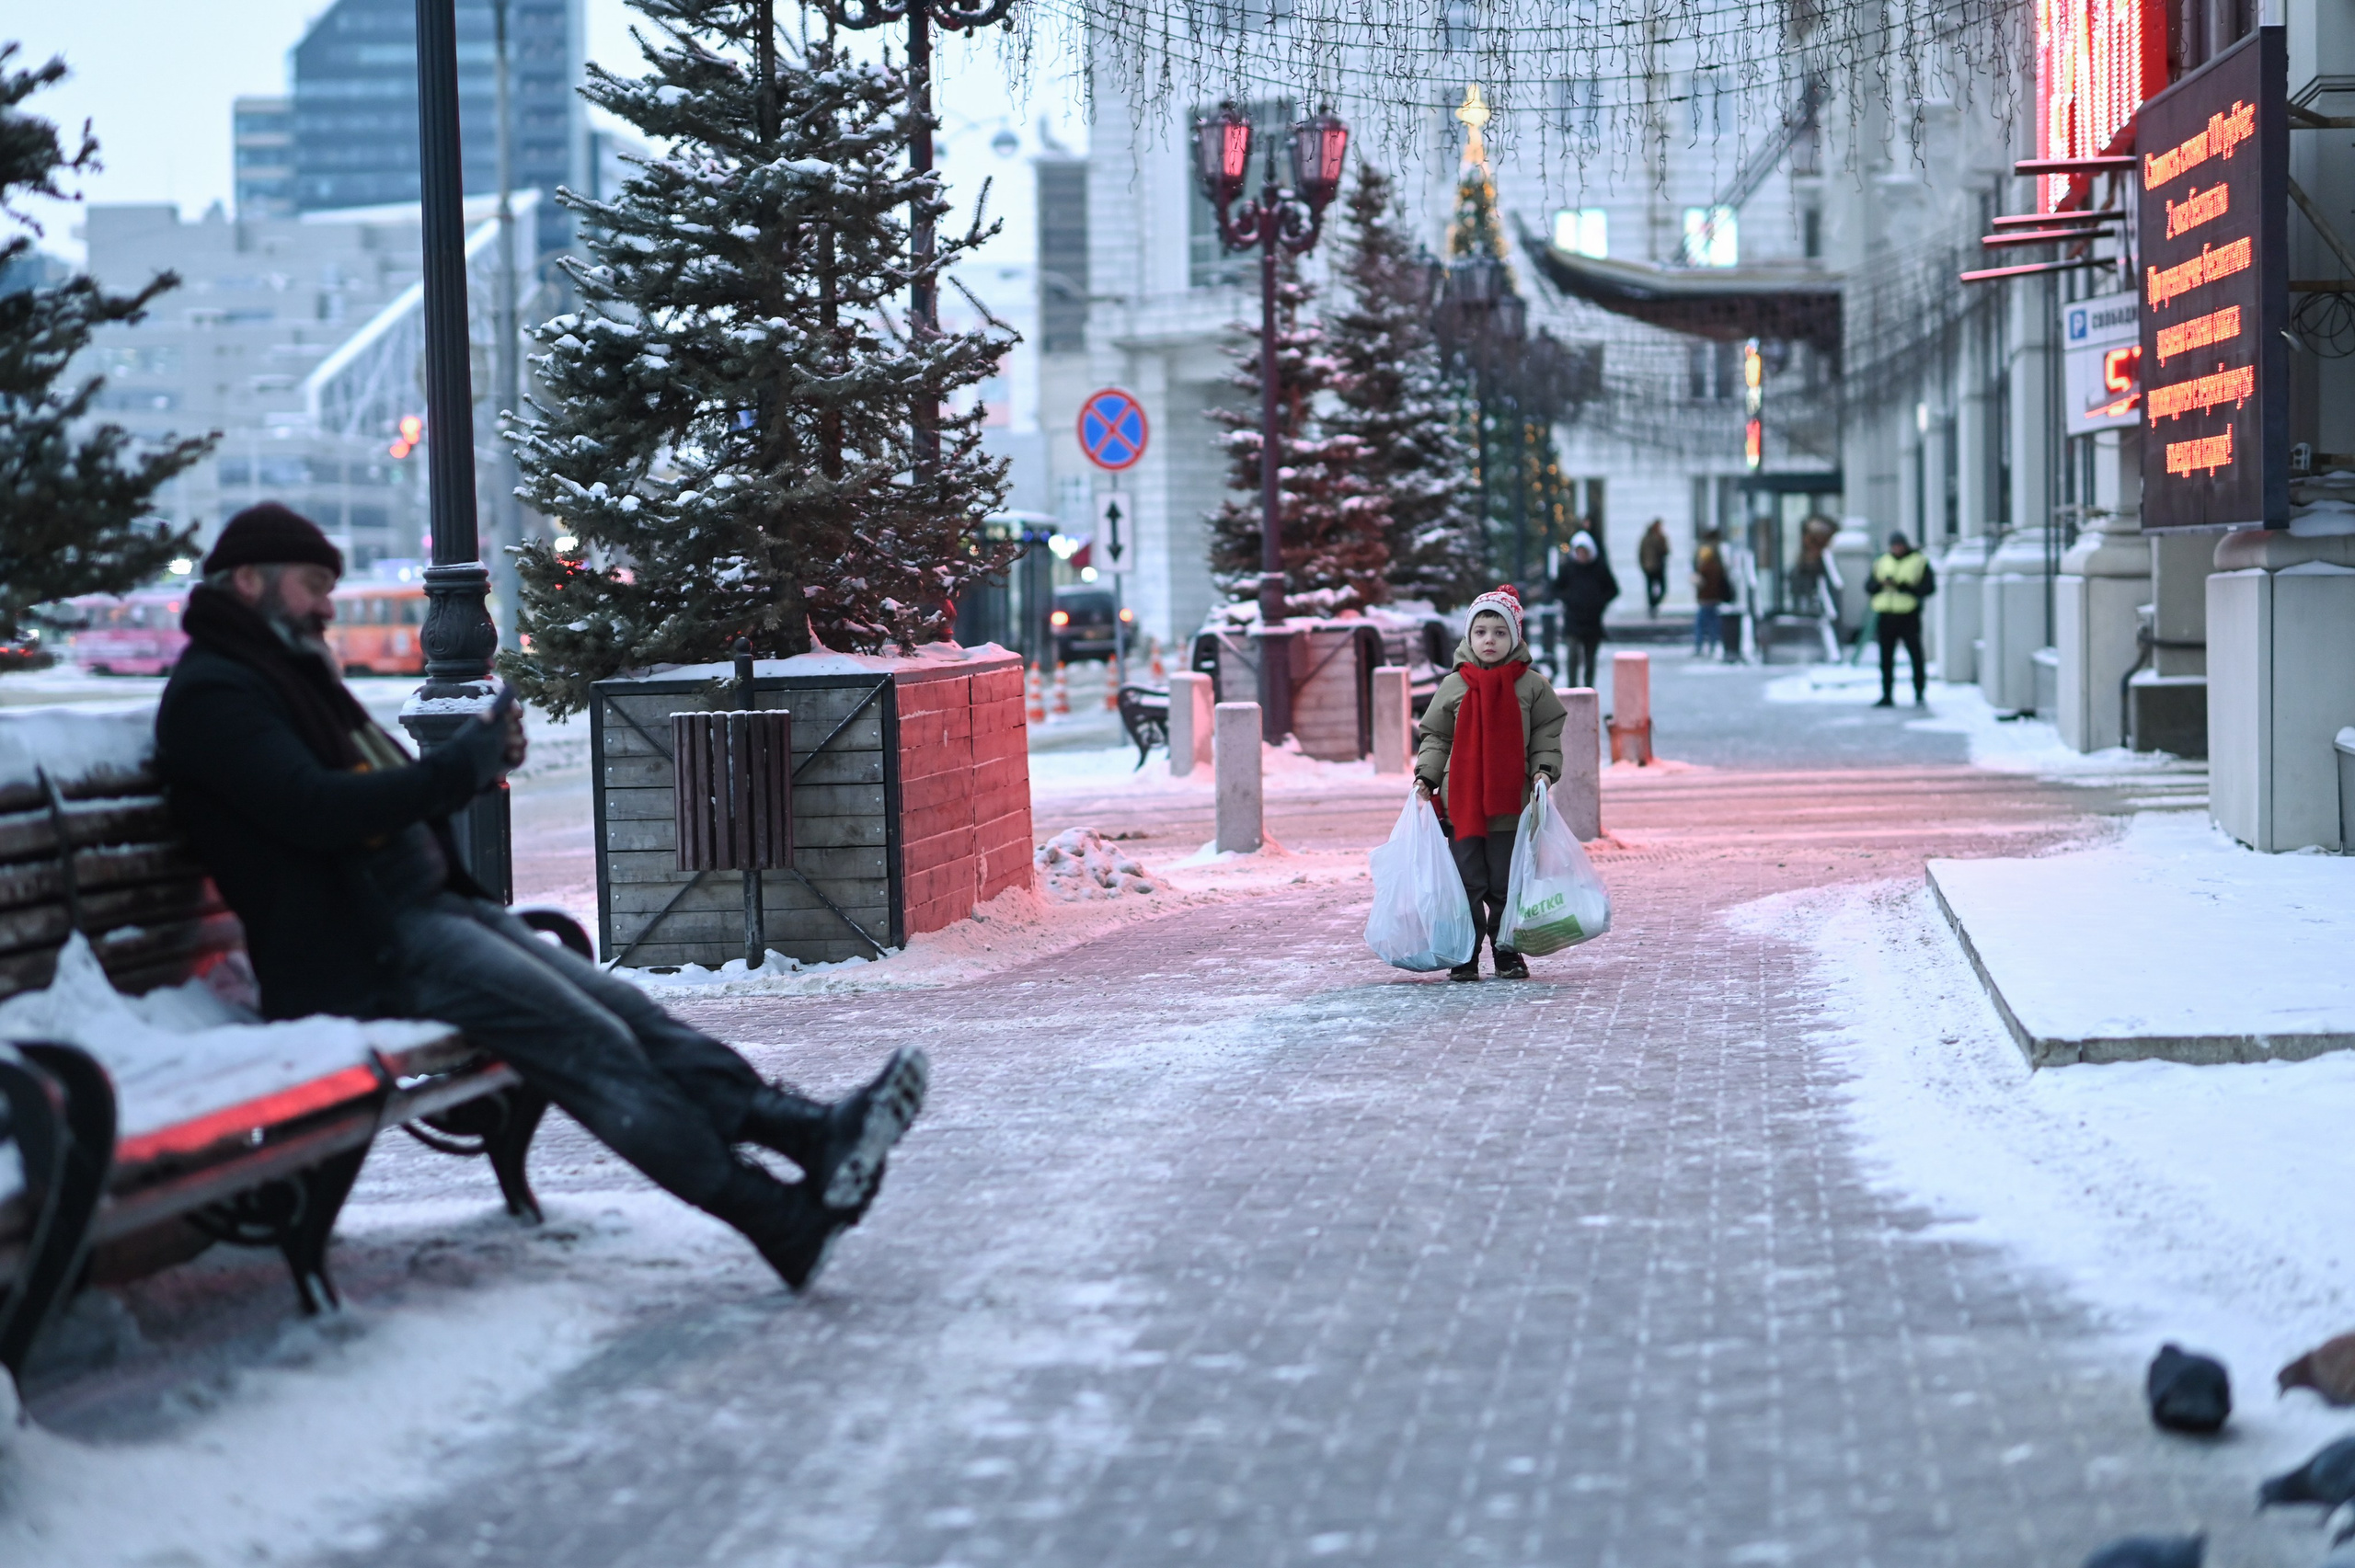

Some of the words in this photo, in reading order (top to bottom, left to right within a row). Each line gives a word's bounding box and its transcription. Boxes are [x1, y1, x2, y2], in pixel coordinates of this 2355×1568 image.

[2209, 112, 2223, 159] 100
[2166, 200, 2174, 240] 2
[2173, 198, 2189, 236] часа
[2189, 183, 2228, 228] бесплатно
[2203, 236, 2251, 283] бесплатного
